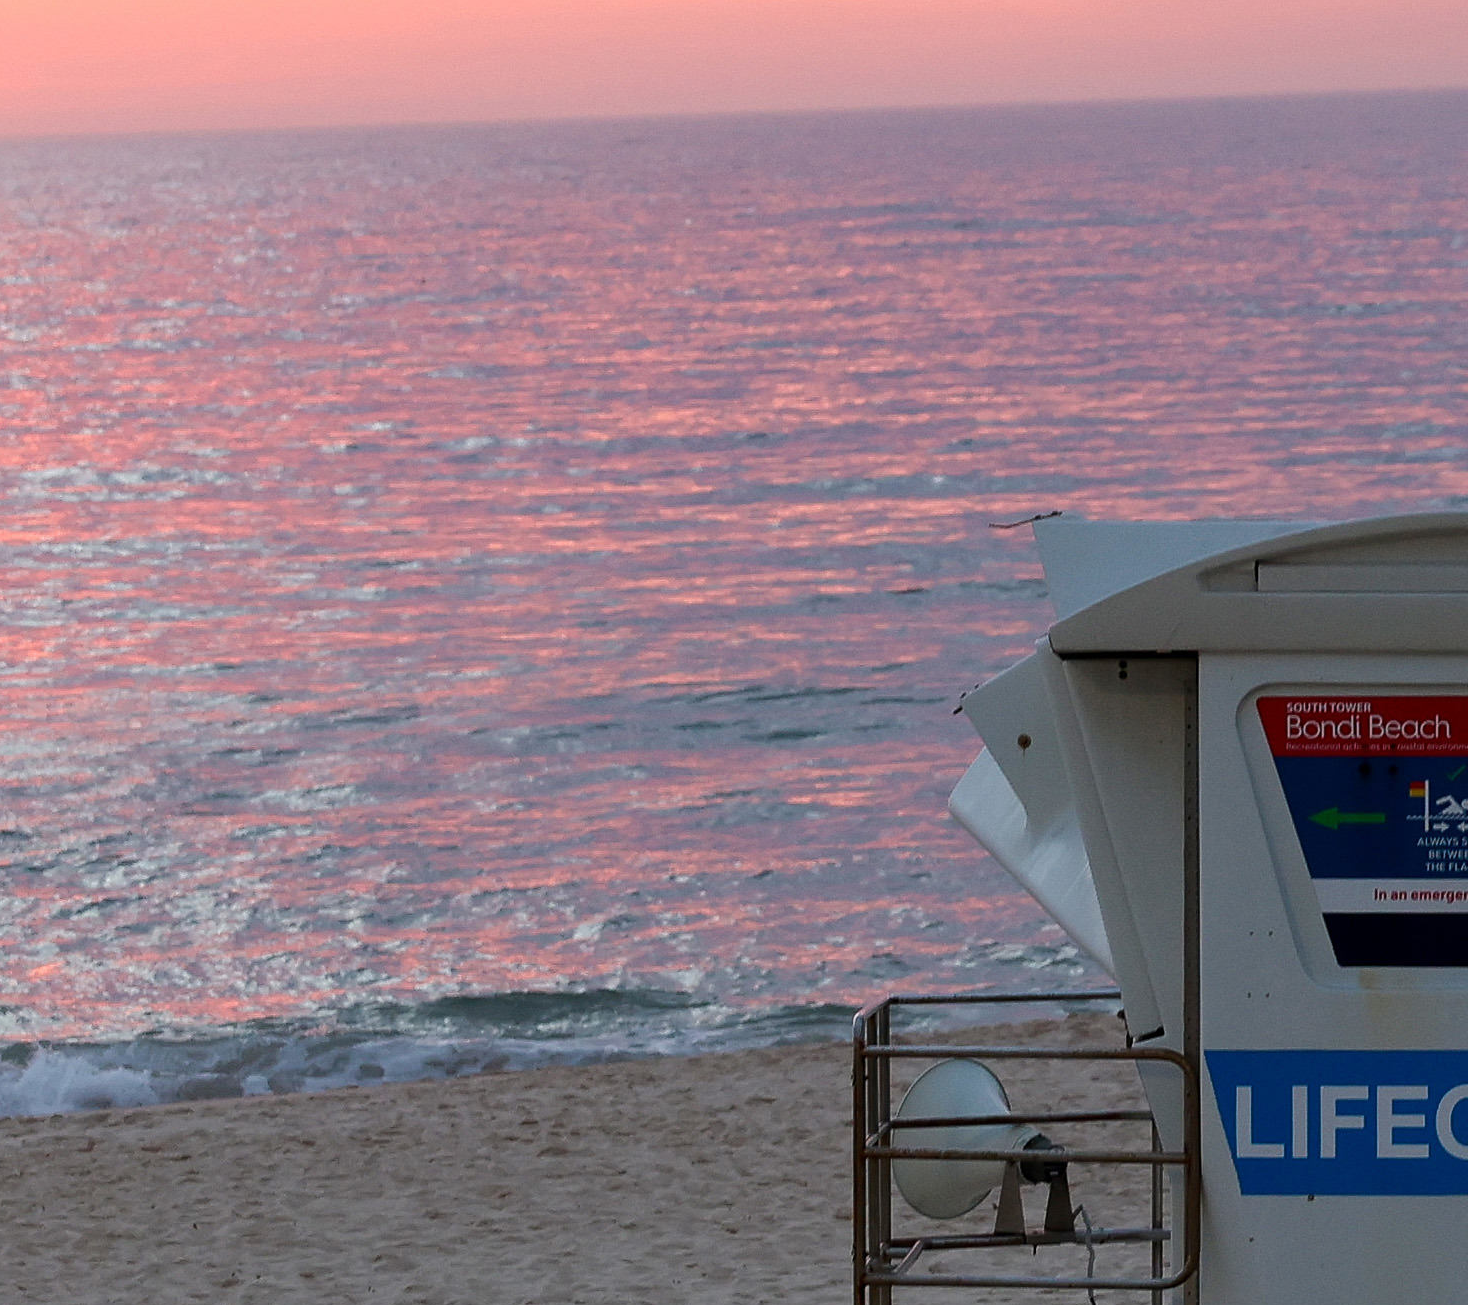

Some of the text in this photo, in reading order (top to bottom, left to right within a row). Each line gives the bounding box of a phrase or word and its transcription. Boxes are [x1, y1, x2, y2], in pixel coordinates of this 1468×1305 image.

[1287, 702, 1371, 713] SOUTH TOWER
[1287, 714, 1451, 739] Bondi Beach
[1417, 837, 1459, 846] ALWAYS
[1426, 862, 1445, 872] THE
[1374, 888, 1387, 900] In
[1391, 891, 1407, 900] an
